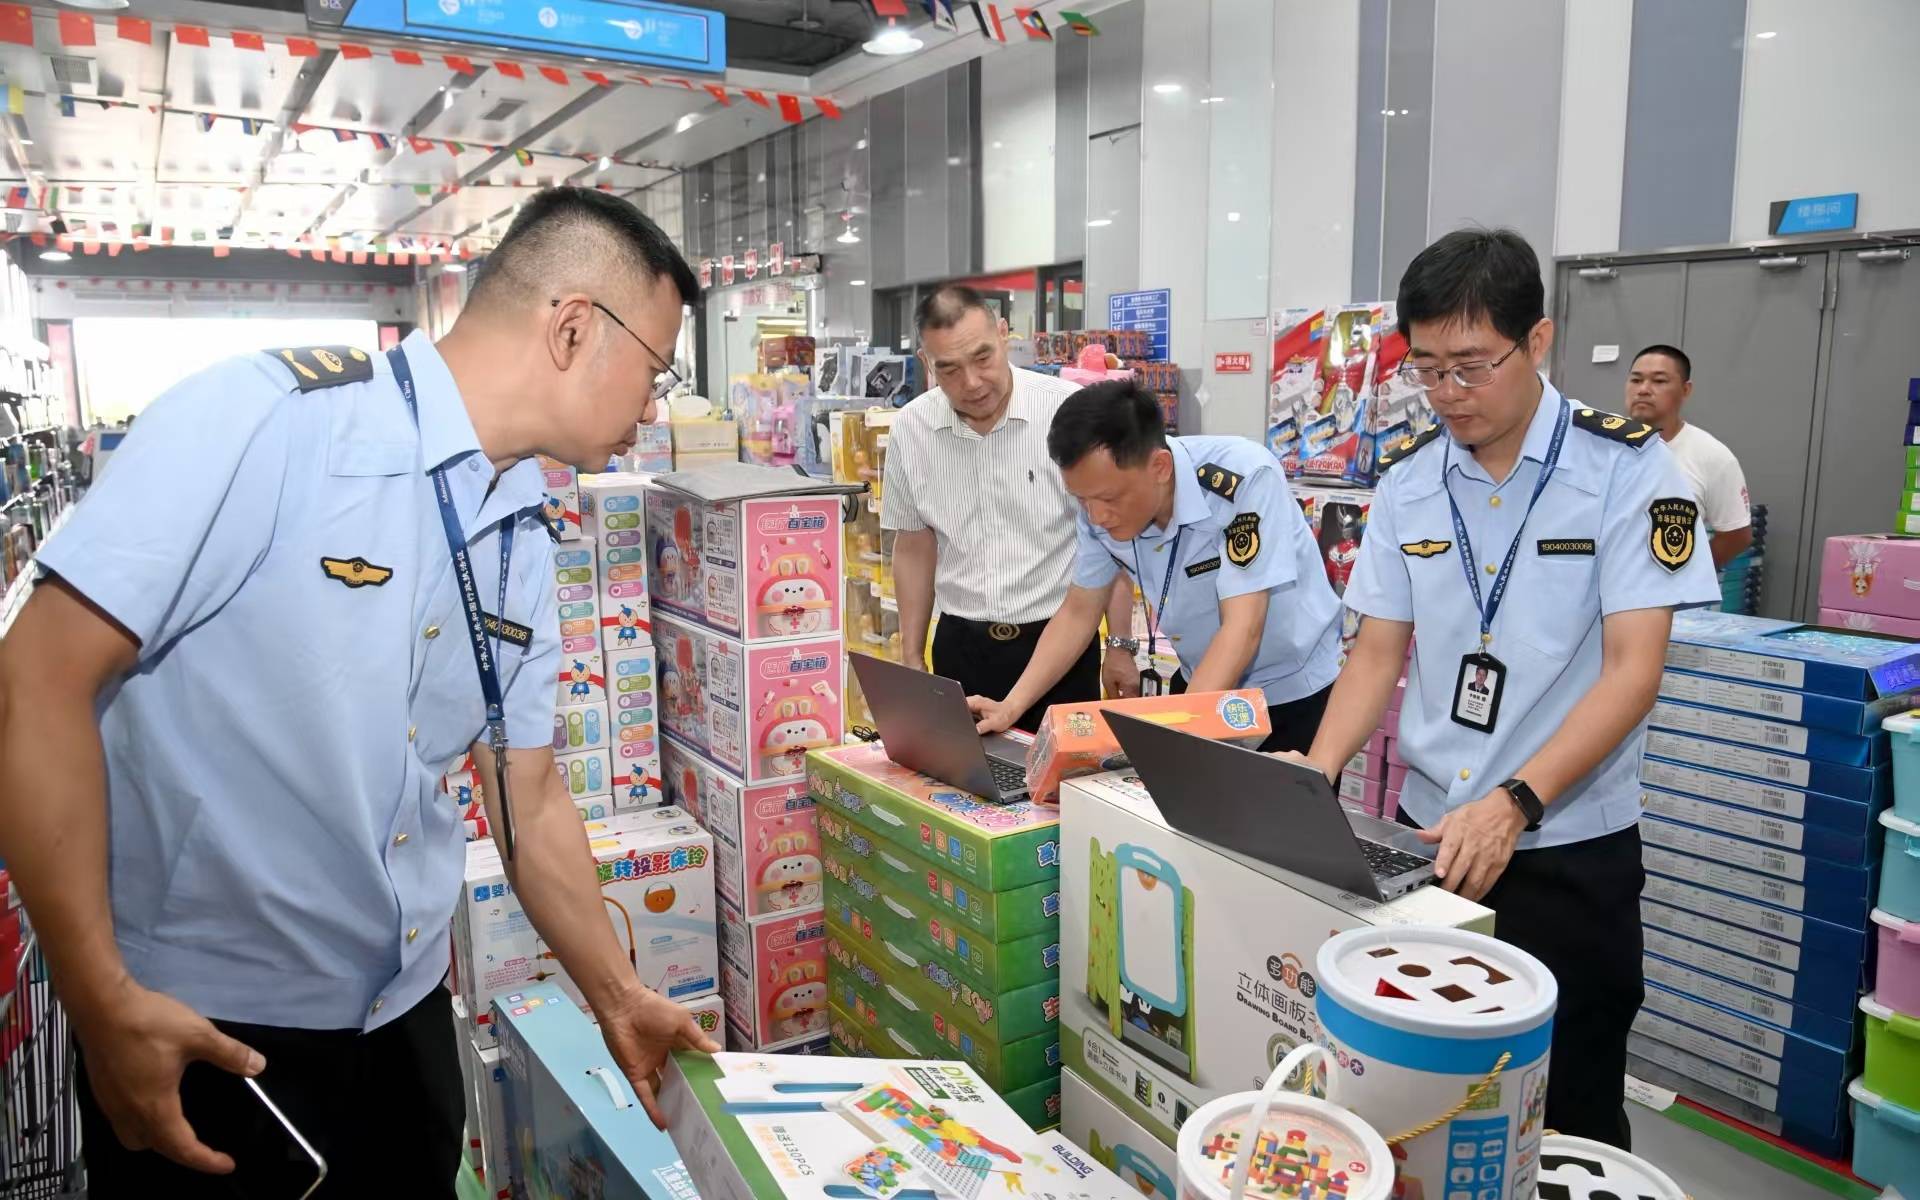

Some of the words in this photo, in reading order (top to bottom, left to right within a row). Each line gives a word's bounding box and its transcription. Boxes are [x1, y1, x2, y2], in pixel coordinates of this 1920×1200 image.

[456, 550, 492, 671] 中华人民共和国行政执法证
[1226, 703, 1248, 713] 快乐
[1268, 956, 1316, 998] 多功能
[1051, 1143, 1095, 1175] BUILDING
